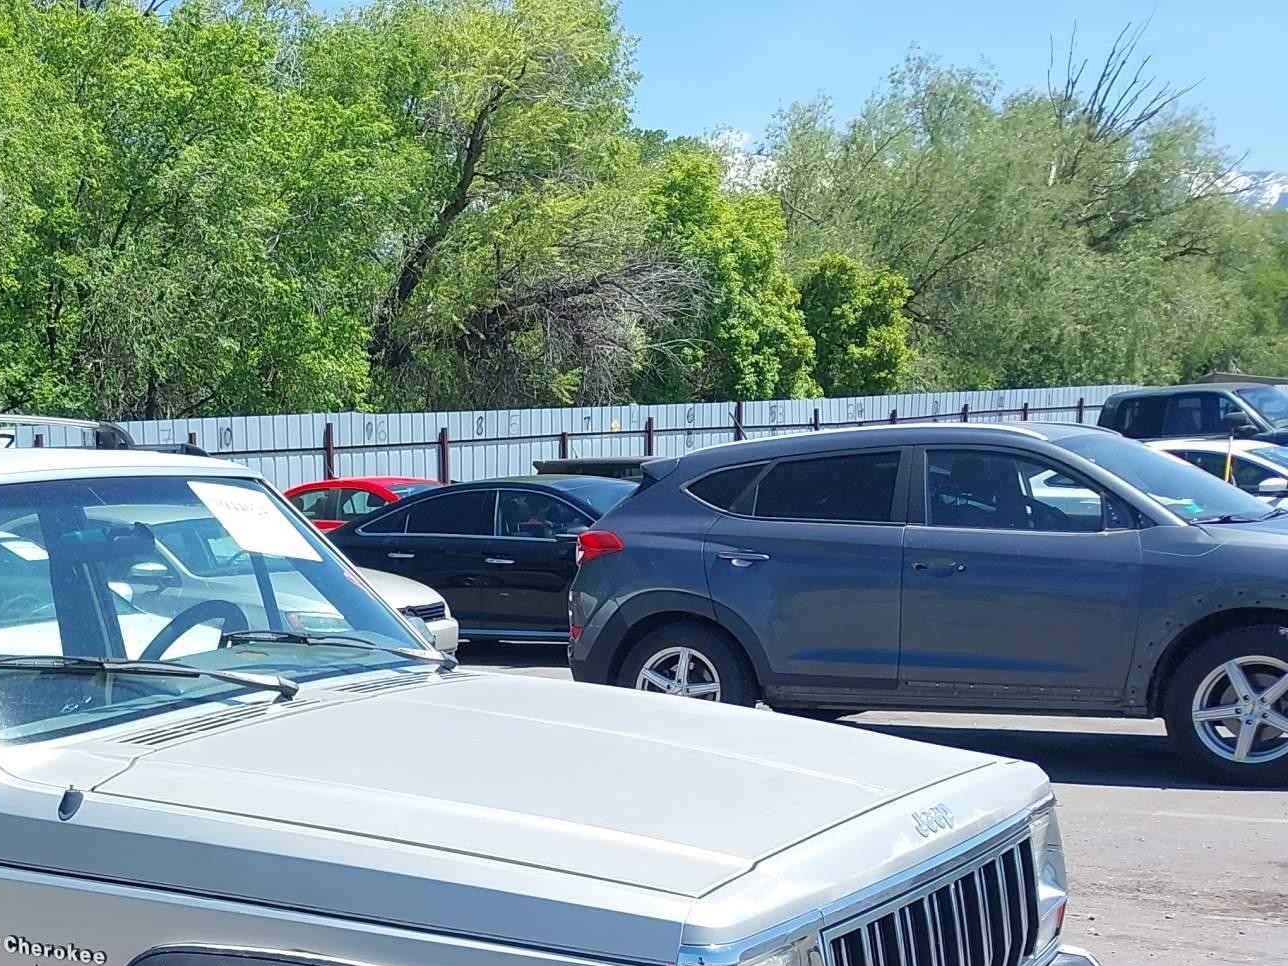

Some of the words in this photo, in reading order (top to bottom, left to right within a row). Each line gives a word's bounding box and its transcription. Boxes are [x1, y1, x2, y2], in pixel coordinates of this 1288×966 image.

[475, 415, 484, 437] 8
[911, 803, 954, 838] Jeep
[3, 934, 107, 965] Cherokee
